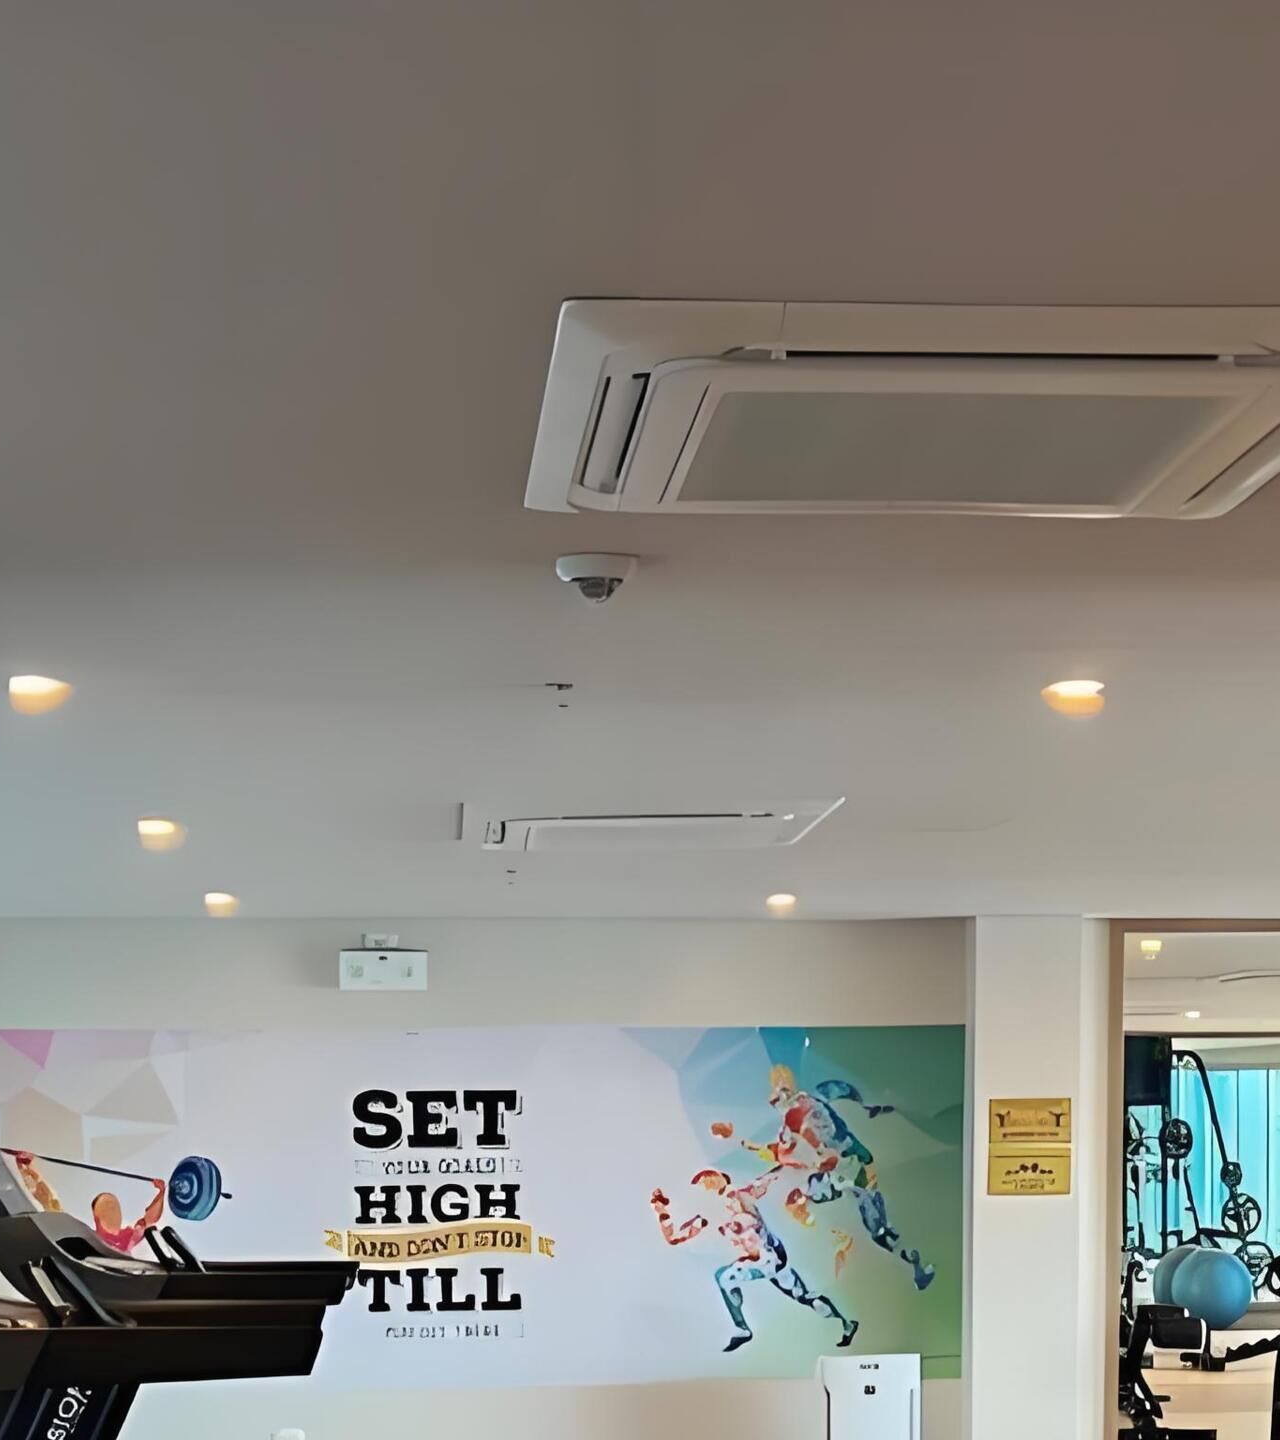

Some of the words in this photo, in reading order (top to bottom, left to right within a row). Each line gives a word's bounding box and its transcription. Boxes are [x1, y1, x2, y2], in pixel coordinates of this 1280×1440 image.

[352, 1089, 520, 1150] SET
[353, 1183, 521, 1224] HIGH
[353, 1236, 400, 1258] AND
[356, 1267, 522, 1312] TILL
